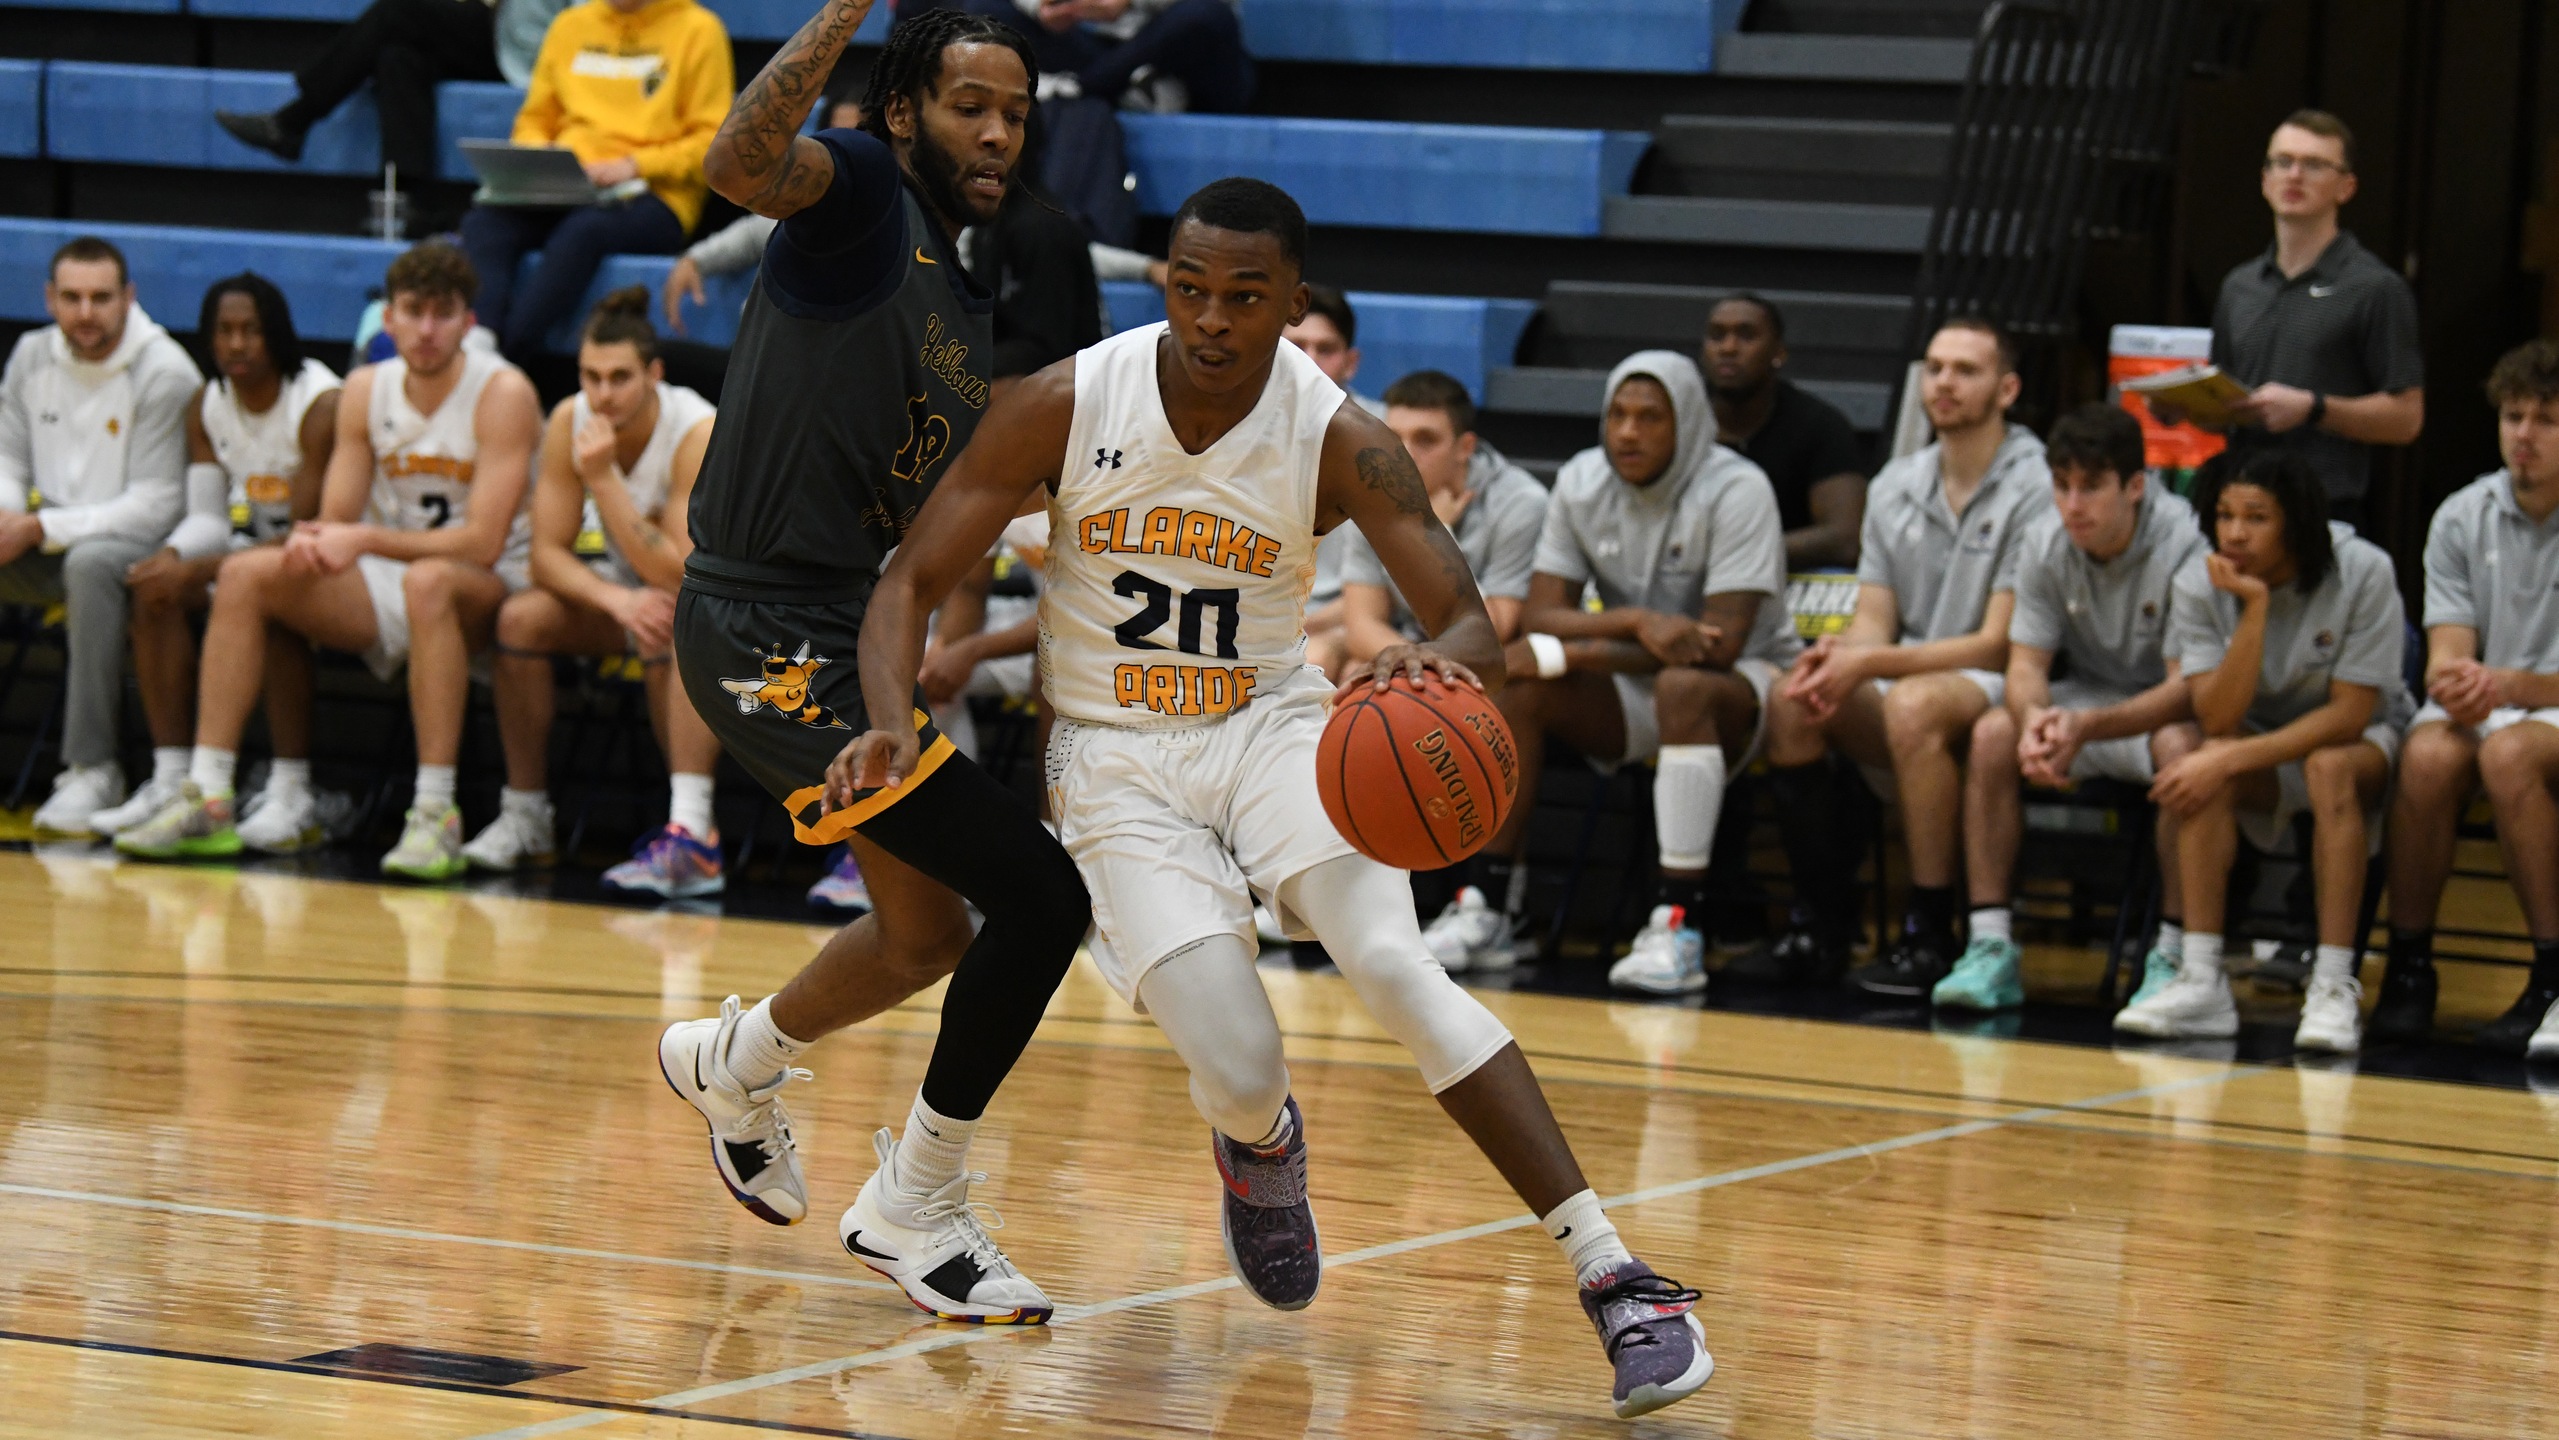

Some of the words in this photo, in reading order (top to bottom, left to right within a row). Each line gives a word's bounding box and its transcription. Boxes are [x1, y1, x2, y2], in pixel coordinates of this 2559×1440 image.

[920, 313, 989, 409] Yellow
[1079, 506, 1281, 578] CLARKE
[1112, 570, 1240, 660] 20
[1114, 663, 1259, 716] PRIDE
[1464, 713, 1518, 797] EGACY
[1175, 942, 1205, 958] ARMOUR
